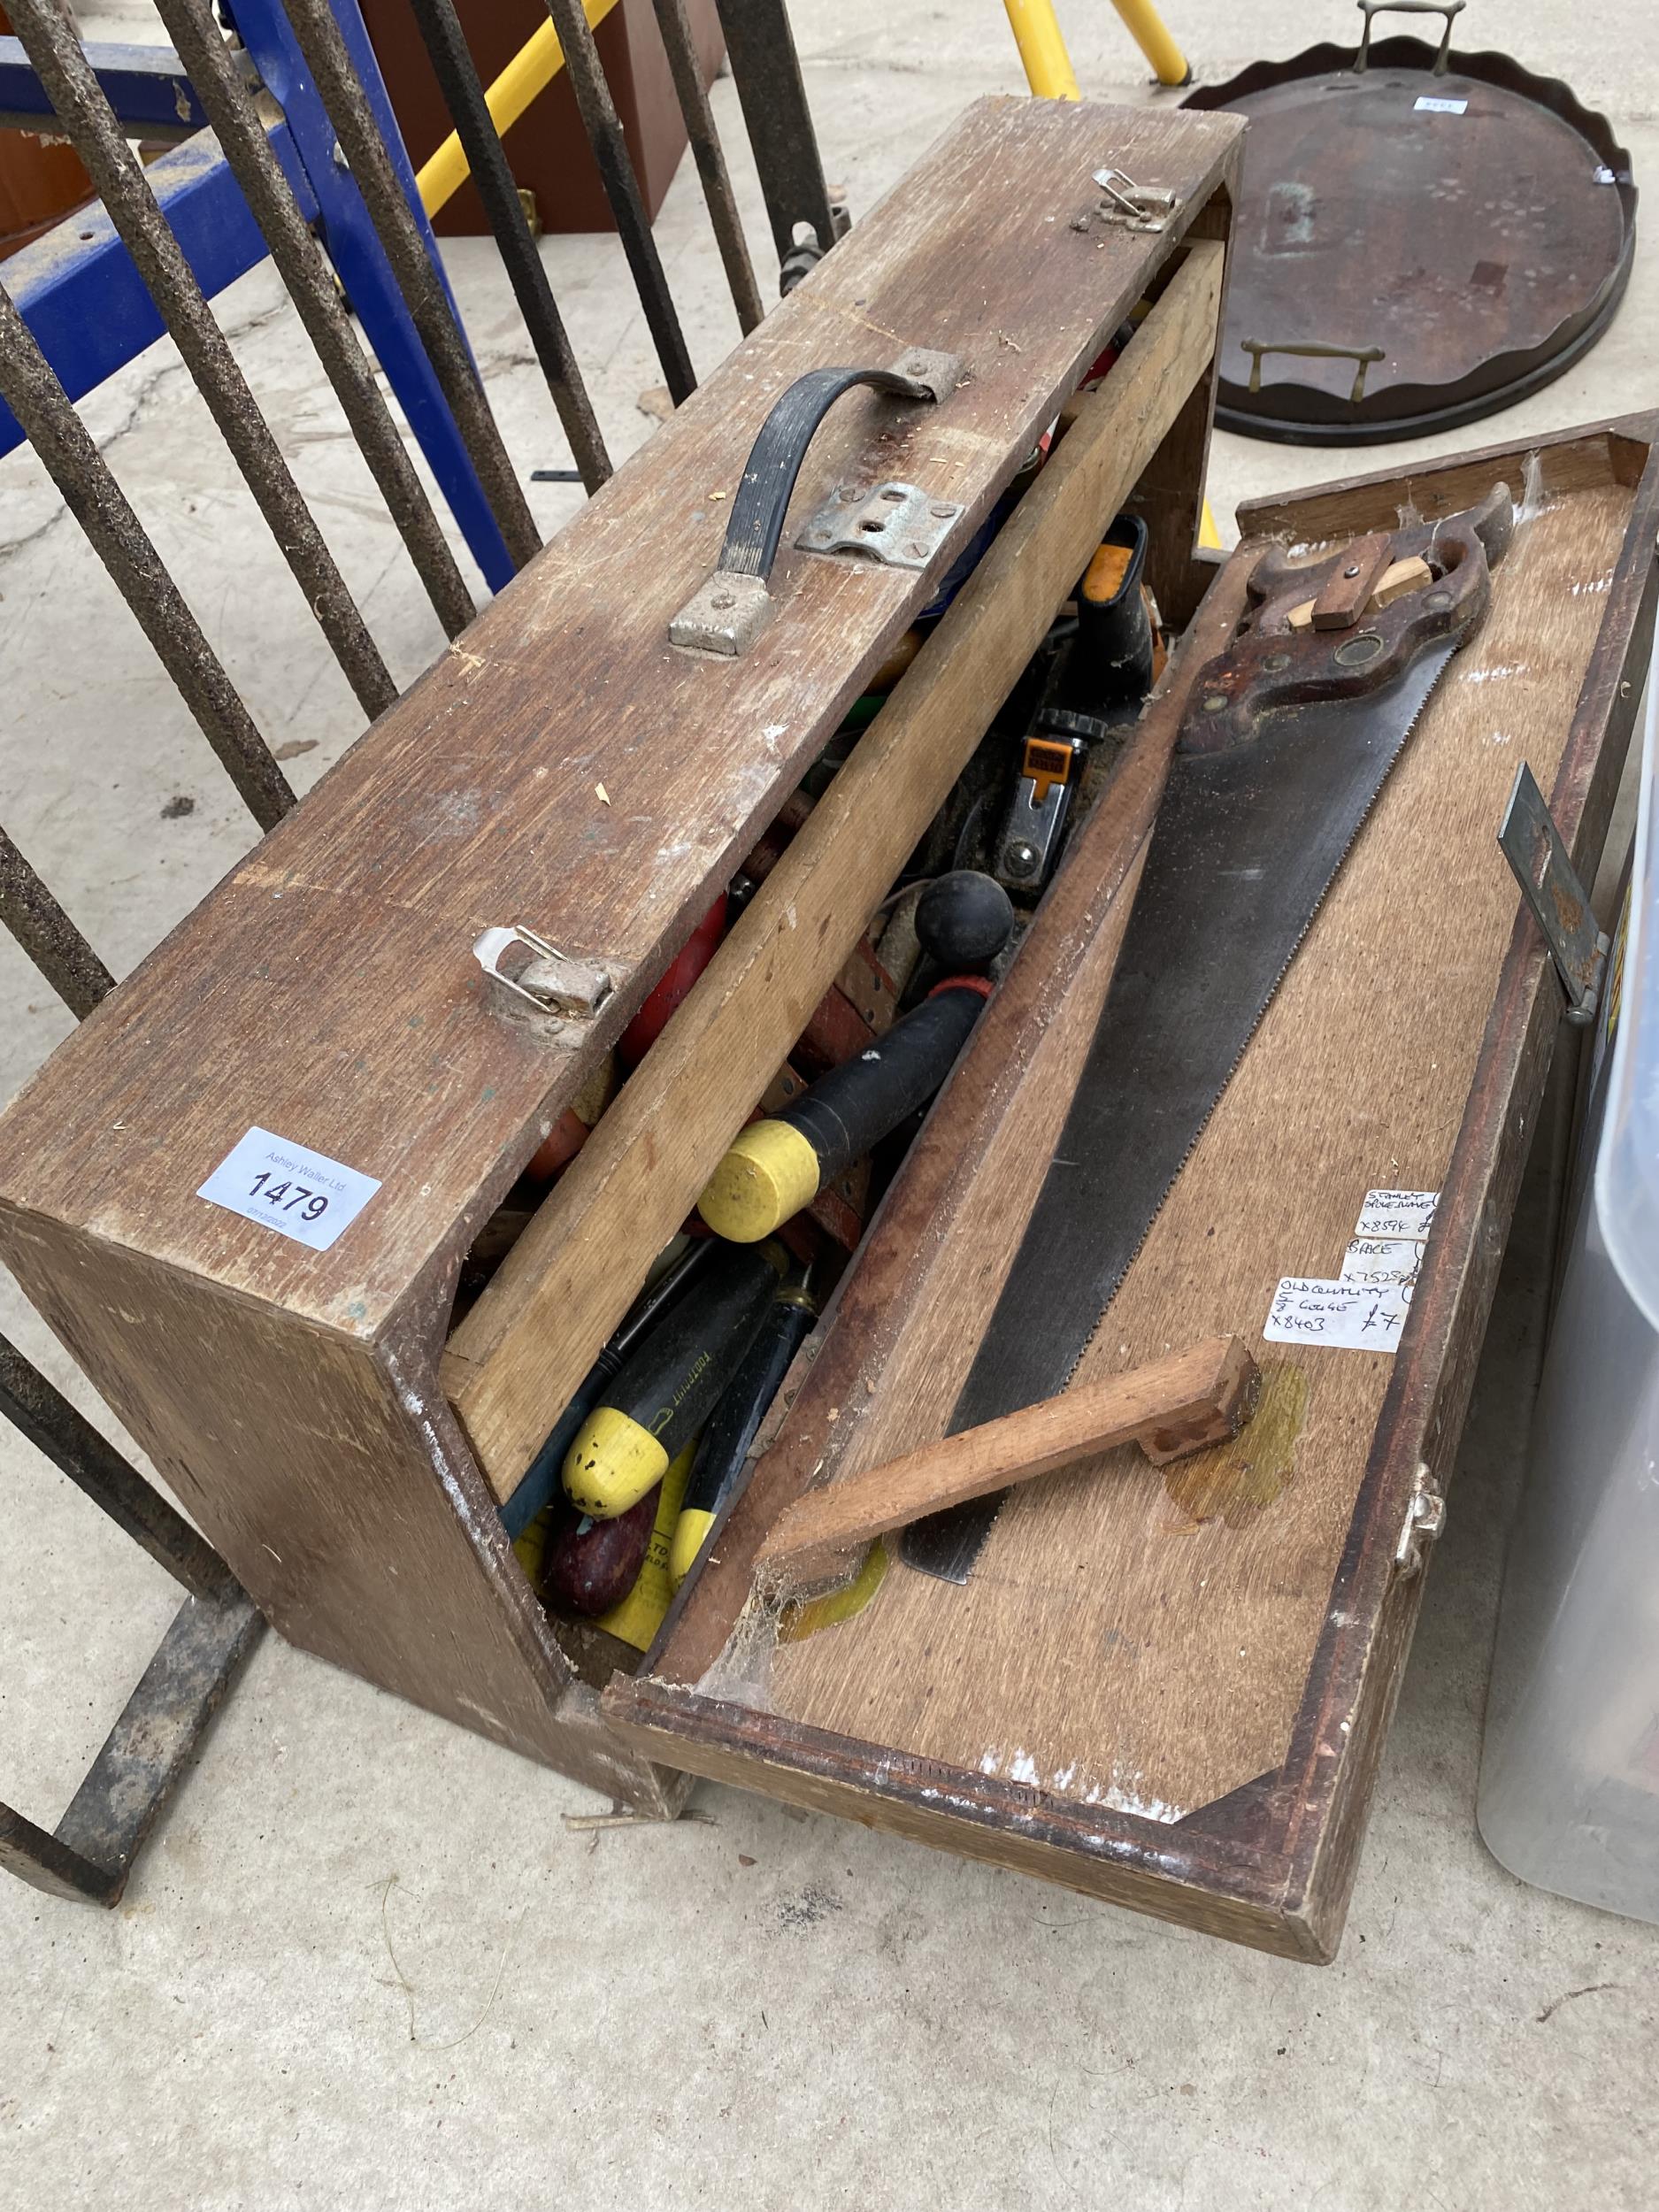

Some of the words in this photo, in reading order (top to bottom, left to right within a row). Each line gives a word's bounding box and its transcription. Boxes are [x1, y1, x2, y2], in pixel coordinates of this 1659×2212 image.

[265, 1152, 299, 1171] Ashley
[298, 1164, 330, 1185] Waller
[330, 1178, 348, 1191] Ltd
[249, 1171, 328, 1221] 1479
[1281, 1280, 1309, 1292] OLD
